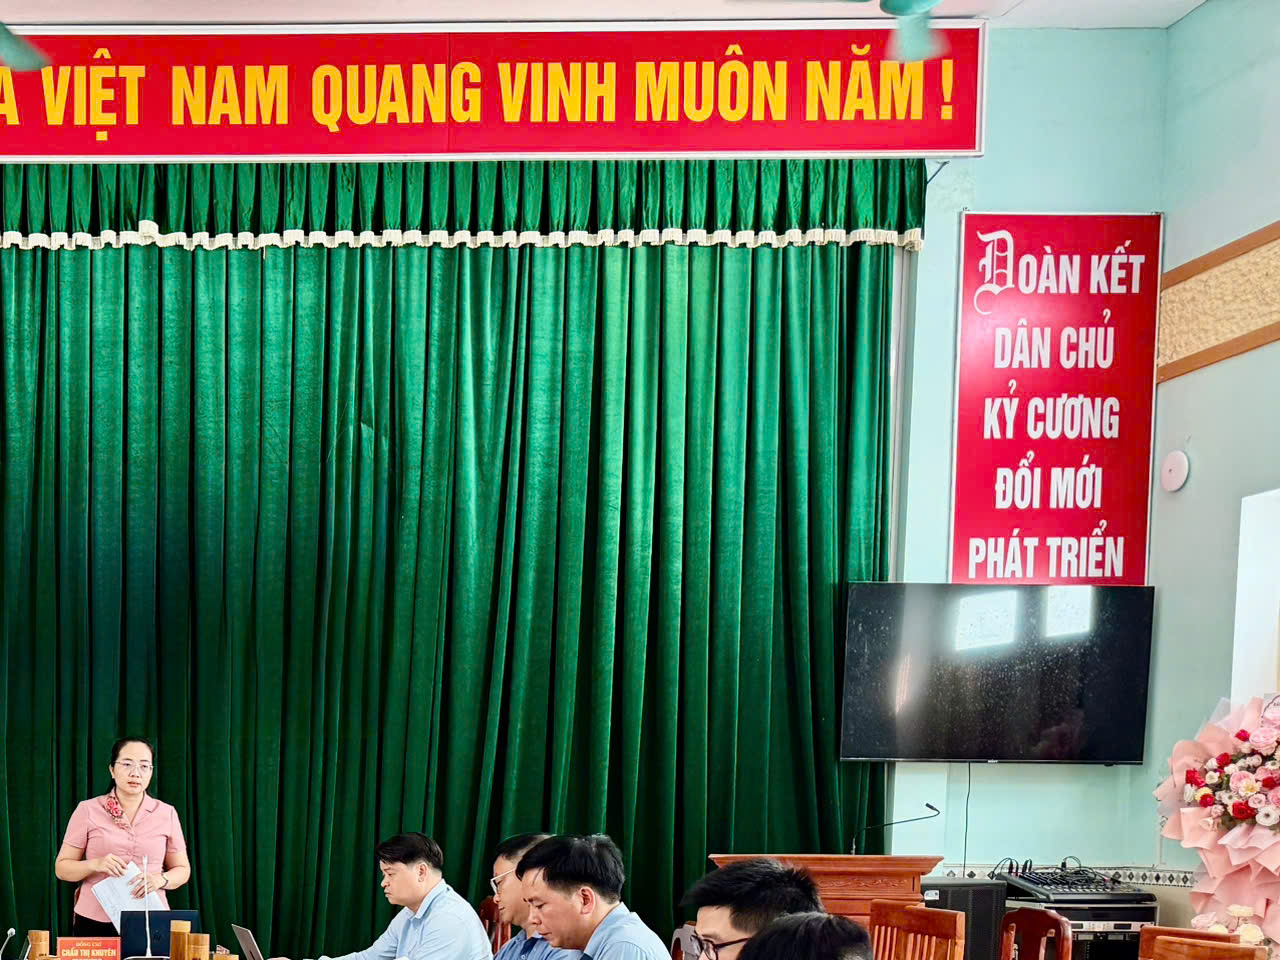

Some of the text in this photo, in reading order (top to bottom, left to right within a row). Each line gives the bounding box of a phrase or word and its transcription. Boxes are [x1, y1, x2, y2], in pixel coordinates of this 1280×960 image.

[41, 48, 145, 140] VIỆT
[173, 66, 288, 124] NAM
[313, 62, 480, 132] QUANG
[498, 63, 616, 122] VINH
[636, 45, 787, 122] MUÔN
[806, 45, 924, 120] NĂM
[1090, 240, 1145, 293] KẾT
[993, 309, 1114, 369] DÂN CHỦ
[984, 379, 1119, 439] KỶ CƯƠNG
[995, 451, 1102, 509] ĐỔI MỚI
[968, 520, 1125, 579] PHÁT TRIỂN
